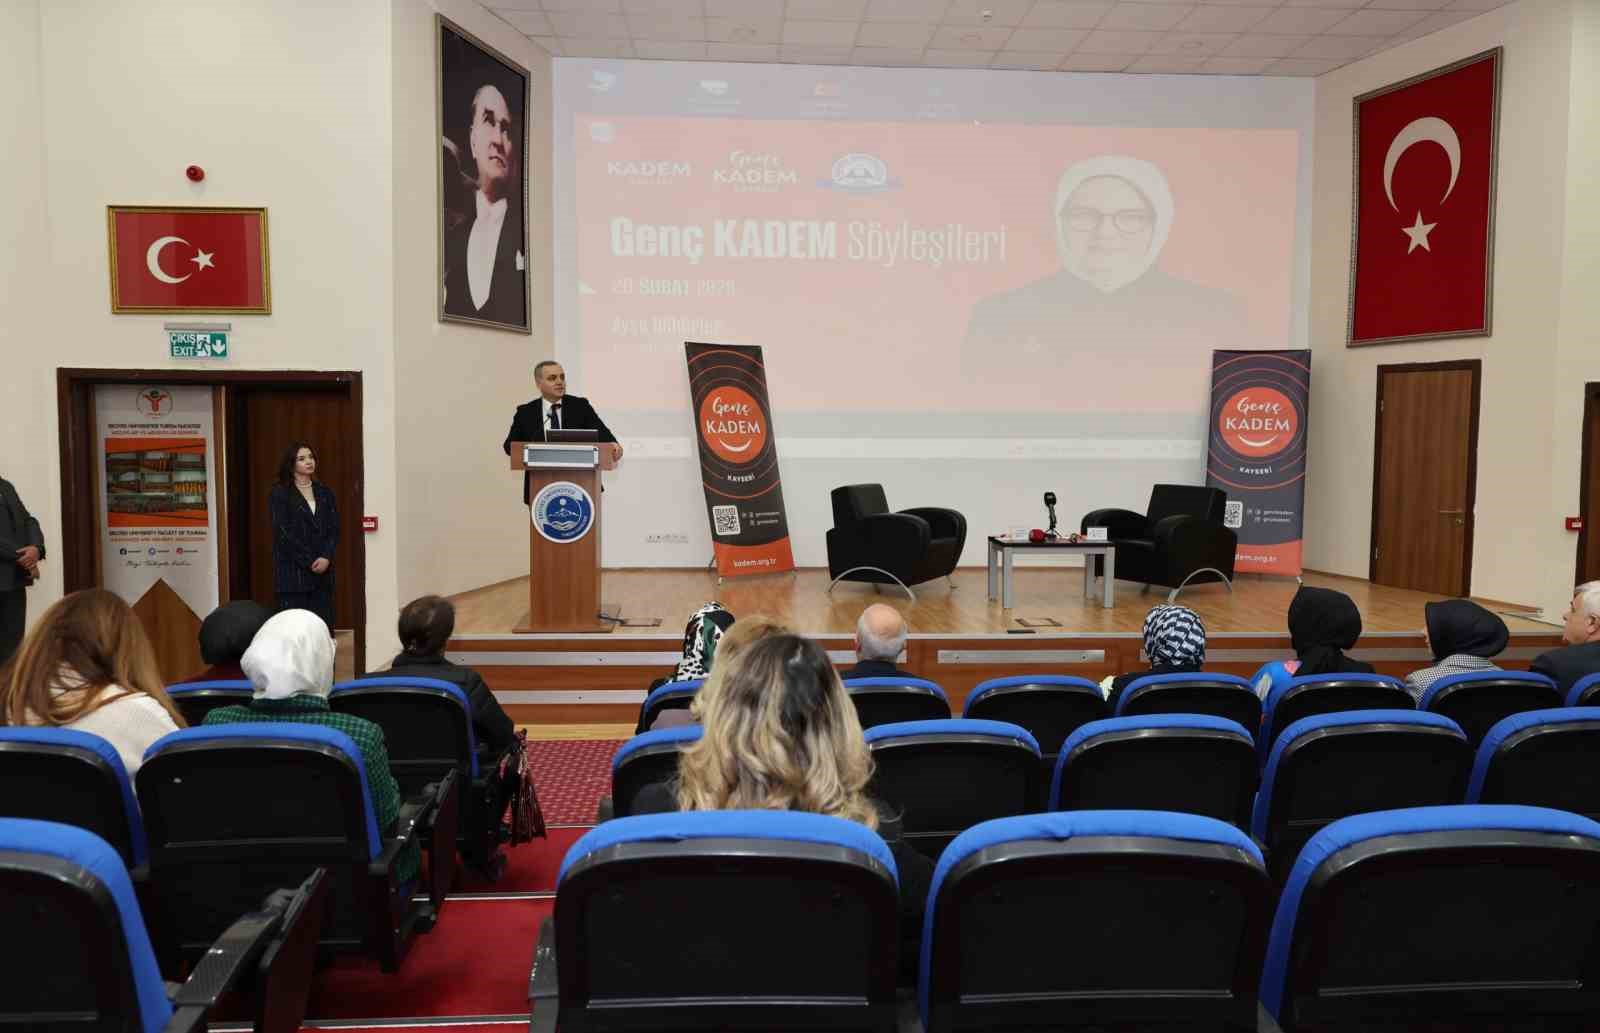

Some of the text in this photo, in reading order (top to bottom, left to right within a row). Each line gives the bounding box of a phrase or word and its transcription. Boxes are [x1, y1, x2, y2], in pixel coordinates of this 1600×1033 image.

[607, 161, 690, 177] KADEM
[712, 168, 799, 185] KADEM
[610, 215, 1008, 266] Genç KADEM Söyleşileri
[173, 346, 196, 356] EXIT
[712, 396, 752, 417] Genç
[1237, 396, 1282, 415] Genç
[706, 419, 761, 434] KADEM
[1225, 417, 1291, 432] KADEM
